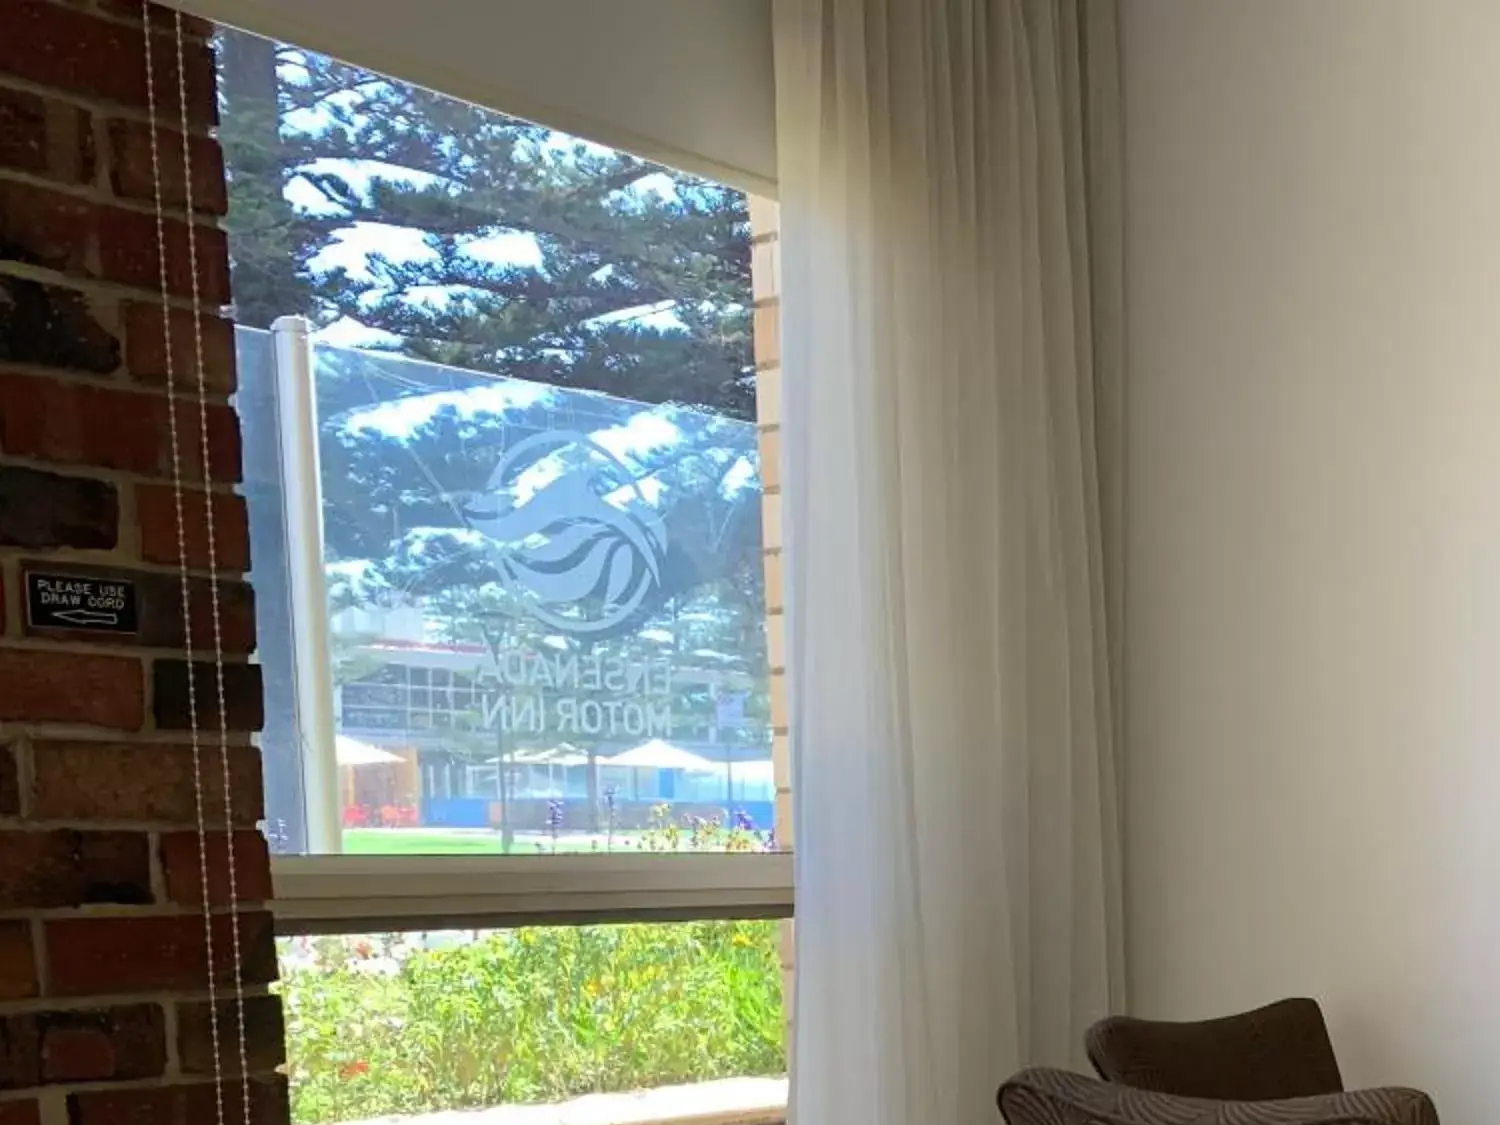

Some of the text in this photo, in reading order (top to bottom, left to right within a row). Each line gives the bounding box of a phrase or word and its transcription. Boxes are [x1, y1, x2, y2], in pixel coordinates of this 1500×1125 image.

[37, 579, 126, 598] PLEASE USE
[40, 592, 125, 610] DRAW CORD
